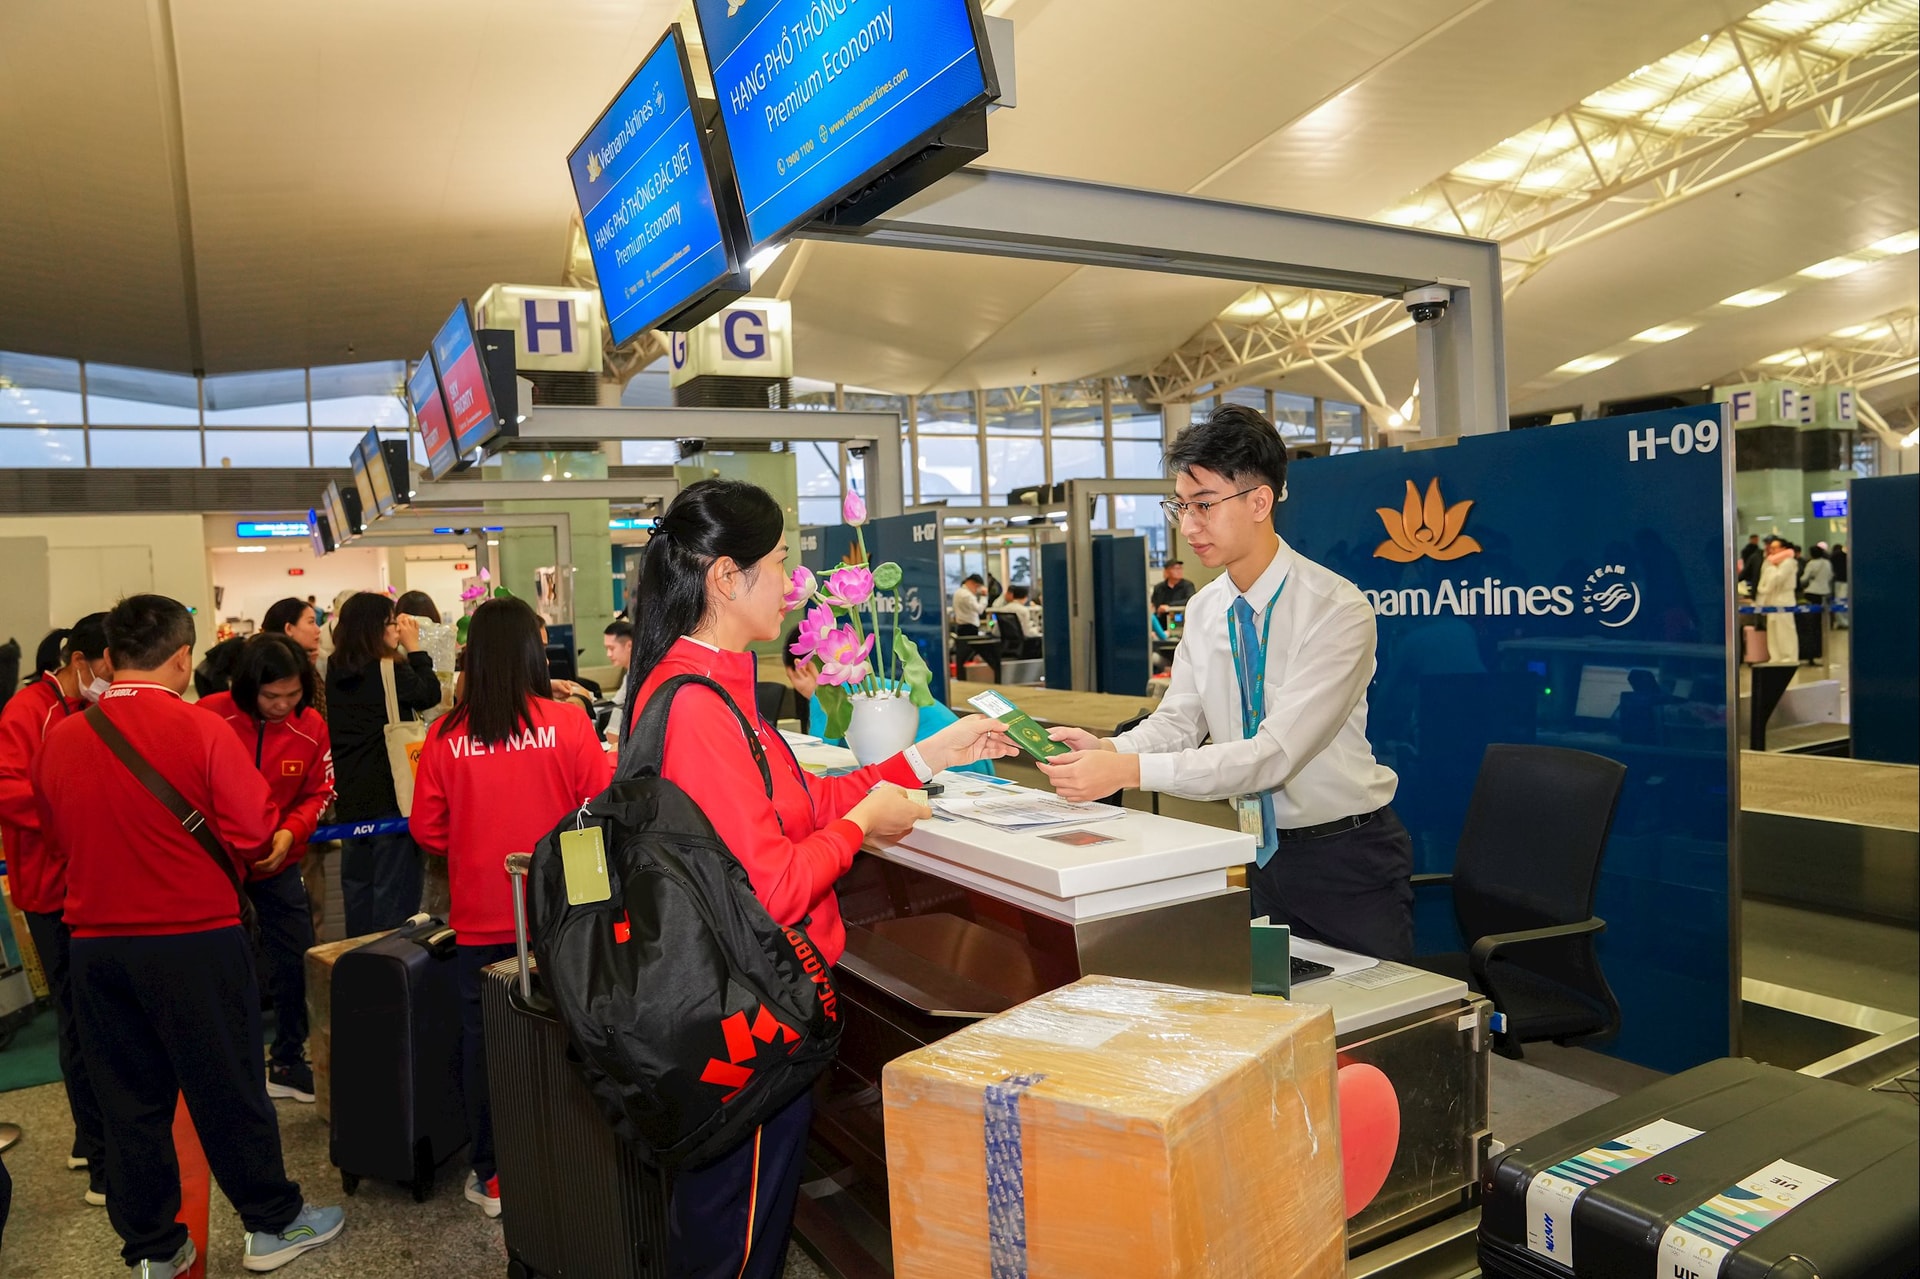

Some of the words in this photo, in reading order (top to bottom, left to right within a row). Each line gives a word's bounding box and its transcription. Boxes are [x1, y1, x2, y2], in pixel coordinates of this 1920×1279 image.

[729, 62, 766, 115] HẠNG
[764, 25, 794, 81] PHỔ
[764, 69, 823, 132] Premium
[821, 5, 892, 83] Economy
[785, 150, 800, 168] 1900
[800, 139, 814, 157] 1100
[829, 68, 909, 135] www.vietnamairlines.com
[594, 219, 616, 251] HẠNG
[612, 198, 629, 234] PHỔ
[627, 179, 656, 217] THÔNG
[653, 163, 674, 194] ĐẶC
[671, 142, 692, 178] BIỆT
[615, 232, 647, 269] Premium
[644, 201, 682, 244] Economy
[524, 300, 573, 353] H
[724, 310, 766, 359] G
[1732, 392, 1751, 421] F
[1783, 389, 1793, 418] F
[1840, 392, 1850, 419] E
[1628, 419, 1720, 462] H-09
[912, 523, 937, 543] H-07
[1433, 577, 1574, 616] Airlines
[1582, 564, 1626, 614] SKYTEAM
[505, 726, 556, 752] NAM
[353, 824, 375, 835] ACV
